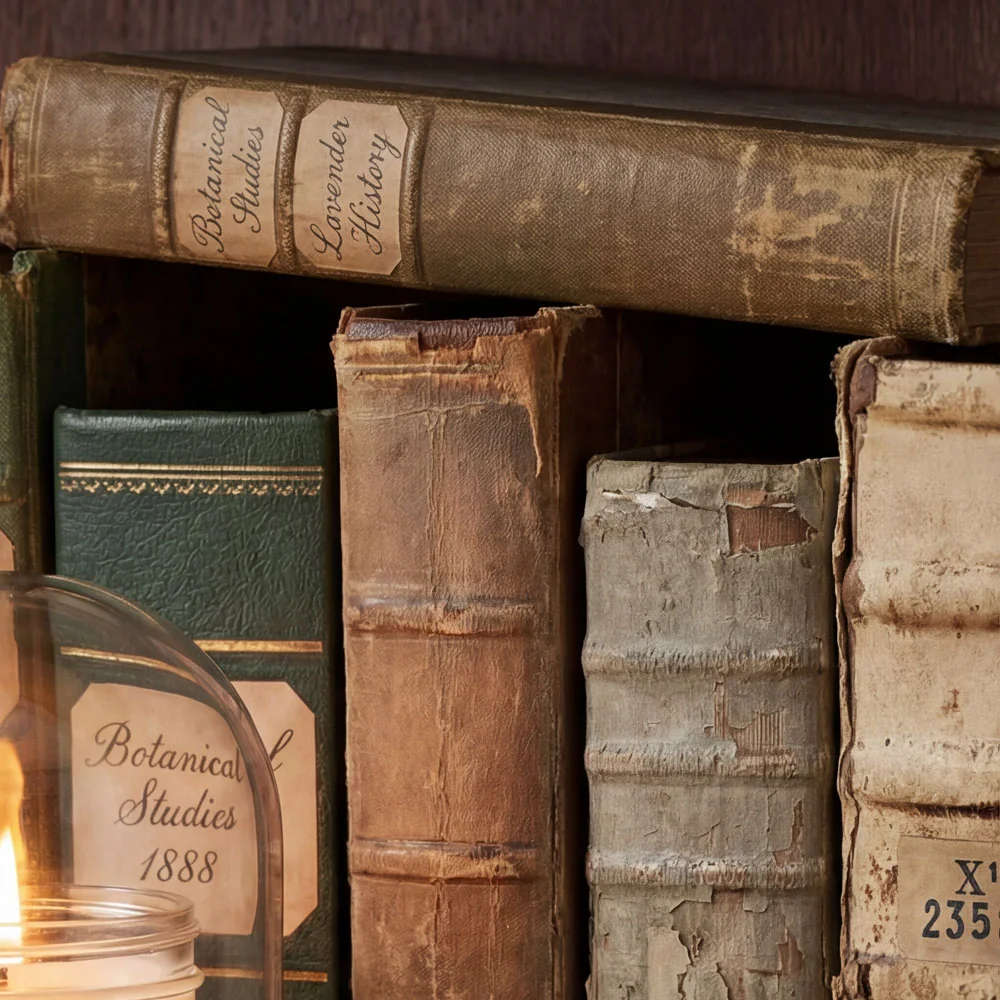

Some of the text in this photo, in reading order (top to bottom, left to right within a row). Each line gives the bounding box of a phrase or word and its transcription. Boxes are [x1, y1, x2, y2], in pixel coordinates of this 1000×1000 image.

[191, 96, 230, 253] Botanical
[230, 125, 265, 234] Studies
[309, 116, 351, 262] Lavender
[347, 130, 402, 256] History
[85, 720, 244, 783] Botanical
[113, 778, 238, 831] Studies
[140, 848, 219, 884] 1888
[921, 898, 1000, 940] 235
